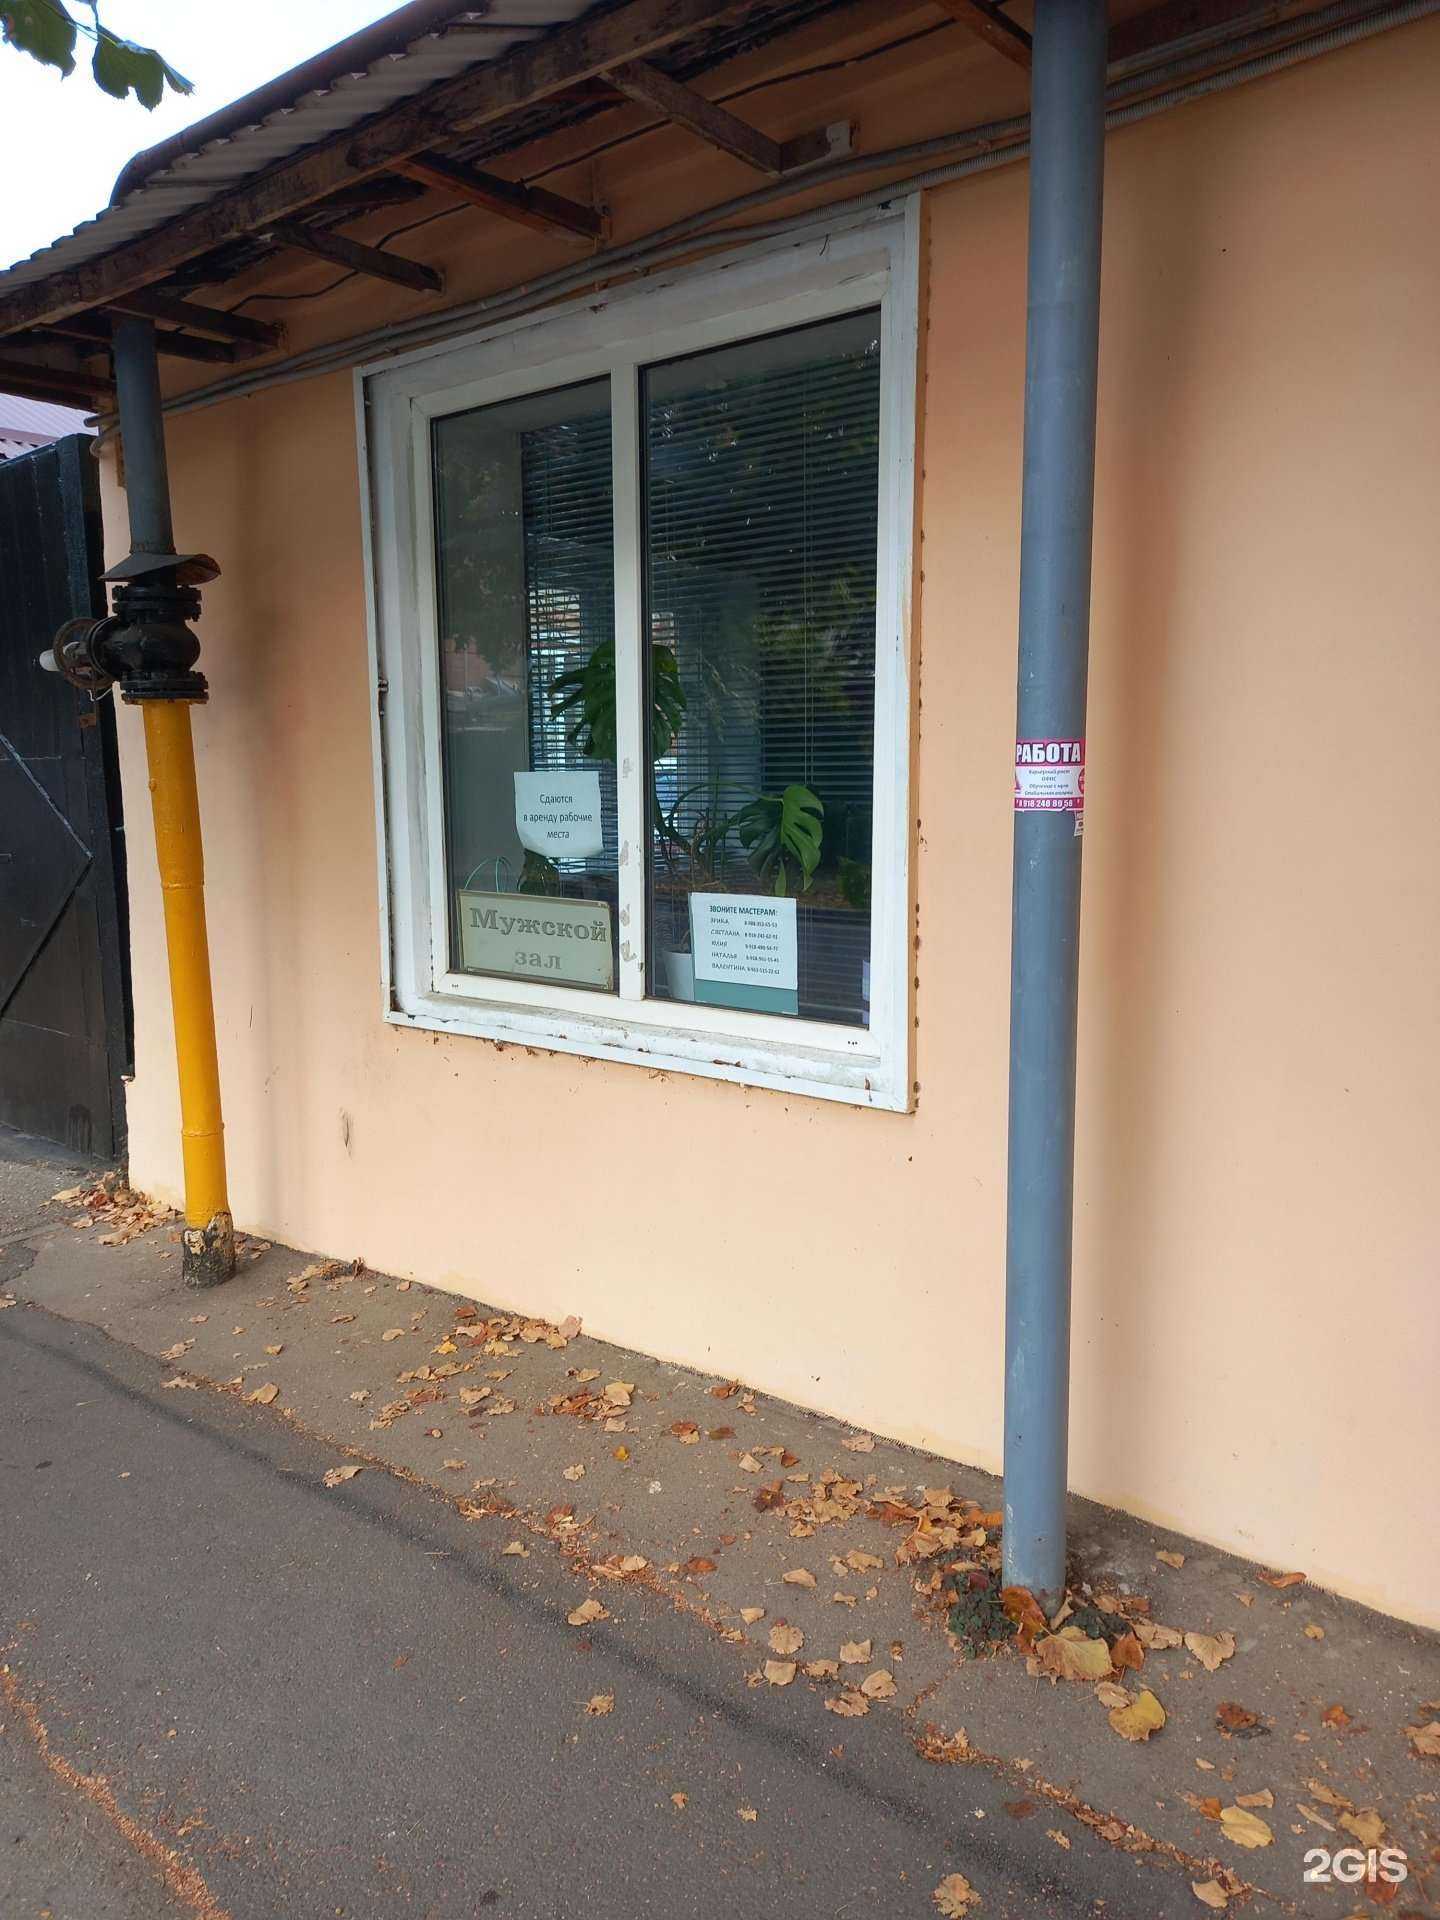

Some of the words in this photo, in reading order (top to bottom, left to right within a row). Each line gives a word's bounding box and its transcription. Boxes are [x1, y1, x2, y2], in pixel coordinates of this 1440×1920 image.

[1016, 742, 1081, 763] РАБОТА
[539, 794, 573, 805] Сдаются
[523, 814, 528, 822] в
[529, 814, 558, 824] аренду
[560, 811, 593, 823] рабочие
[546, 831, 570, 839] места
[709, 905, 738, 914] ЗВОНИТЕ
[738, 907, 778, 916] МАСТЕРАМ:
[469, 907, 607, 942] Мужской
[710, 929, 740, 937] СВЕТЛАНА
[514, 951, 562, 970] зал
[711, 963, 746, 973] ВАЛЕНТИНА
